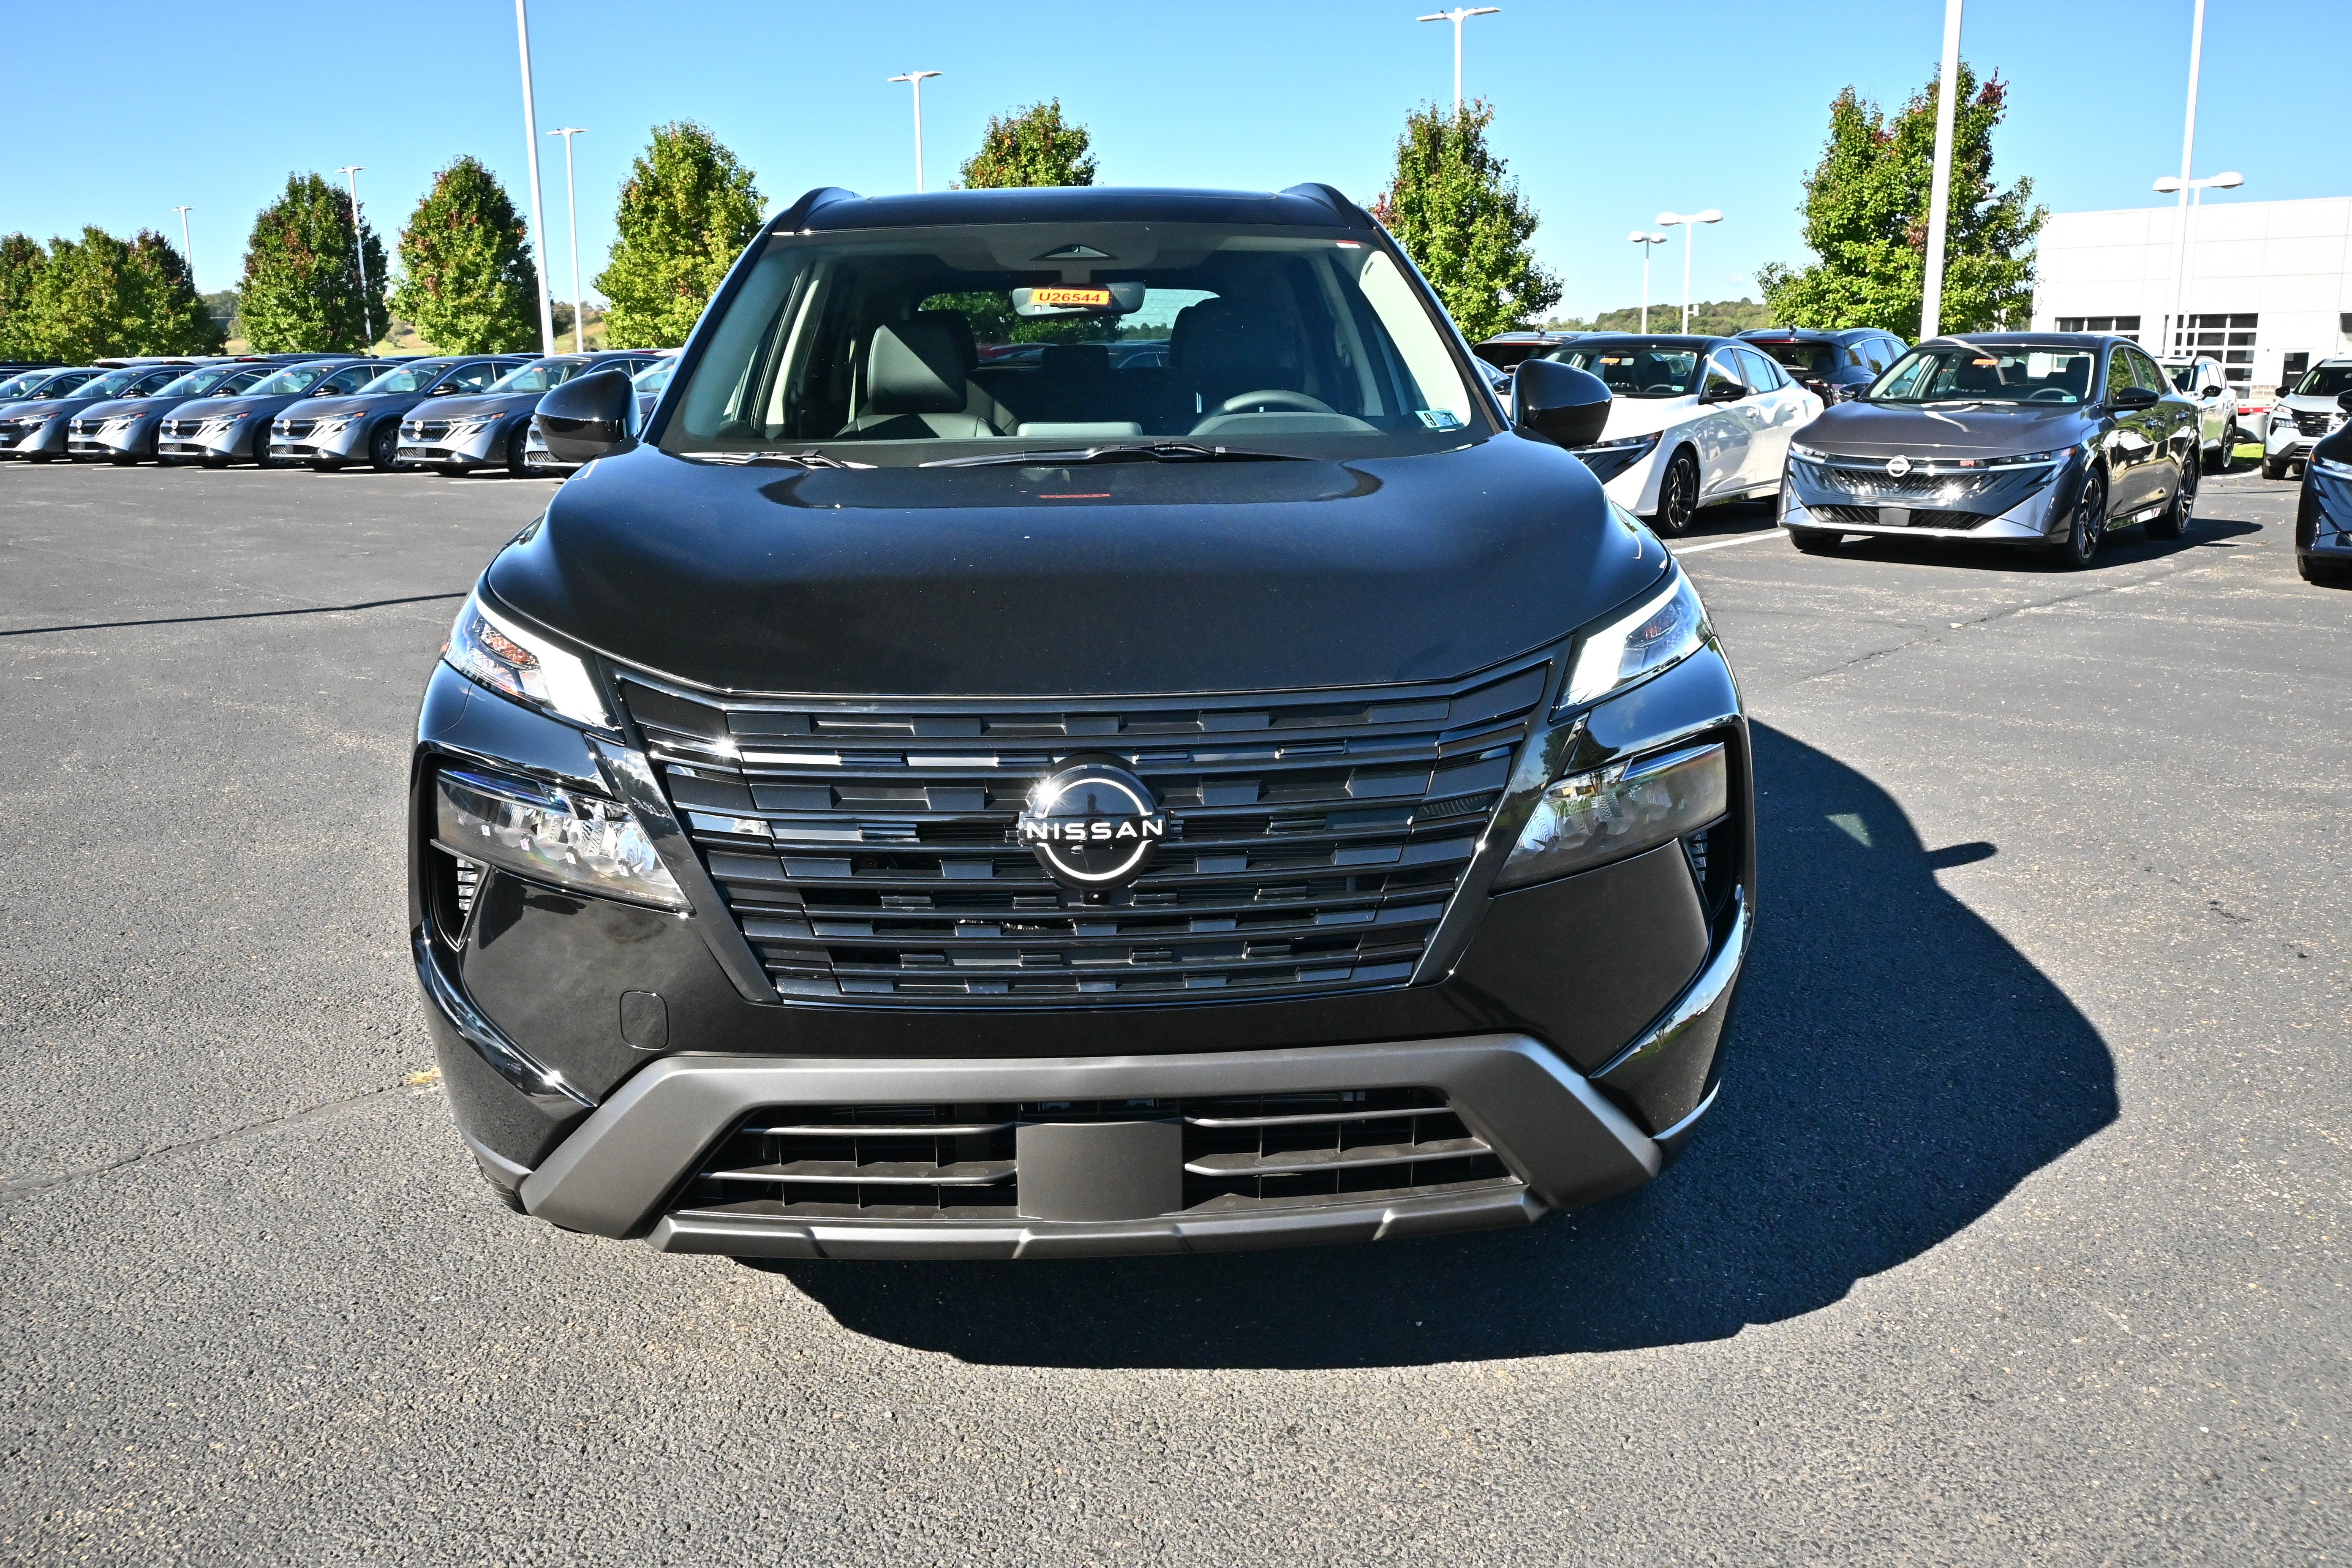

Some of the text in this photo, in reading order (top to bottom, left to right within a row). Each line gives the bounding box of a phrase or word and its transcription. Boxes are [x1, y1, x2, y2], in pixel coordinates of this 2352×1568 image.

[1039, 292, 1100, 302] U26544
[1424, 413, 1437, 426] 9
[1026, 819, 1163, 840] NISSAN
